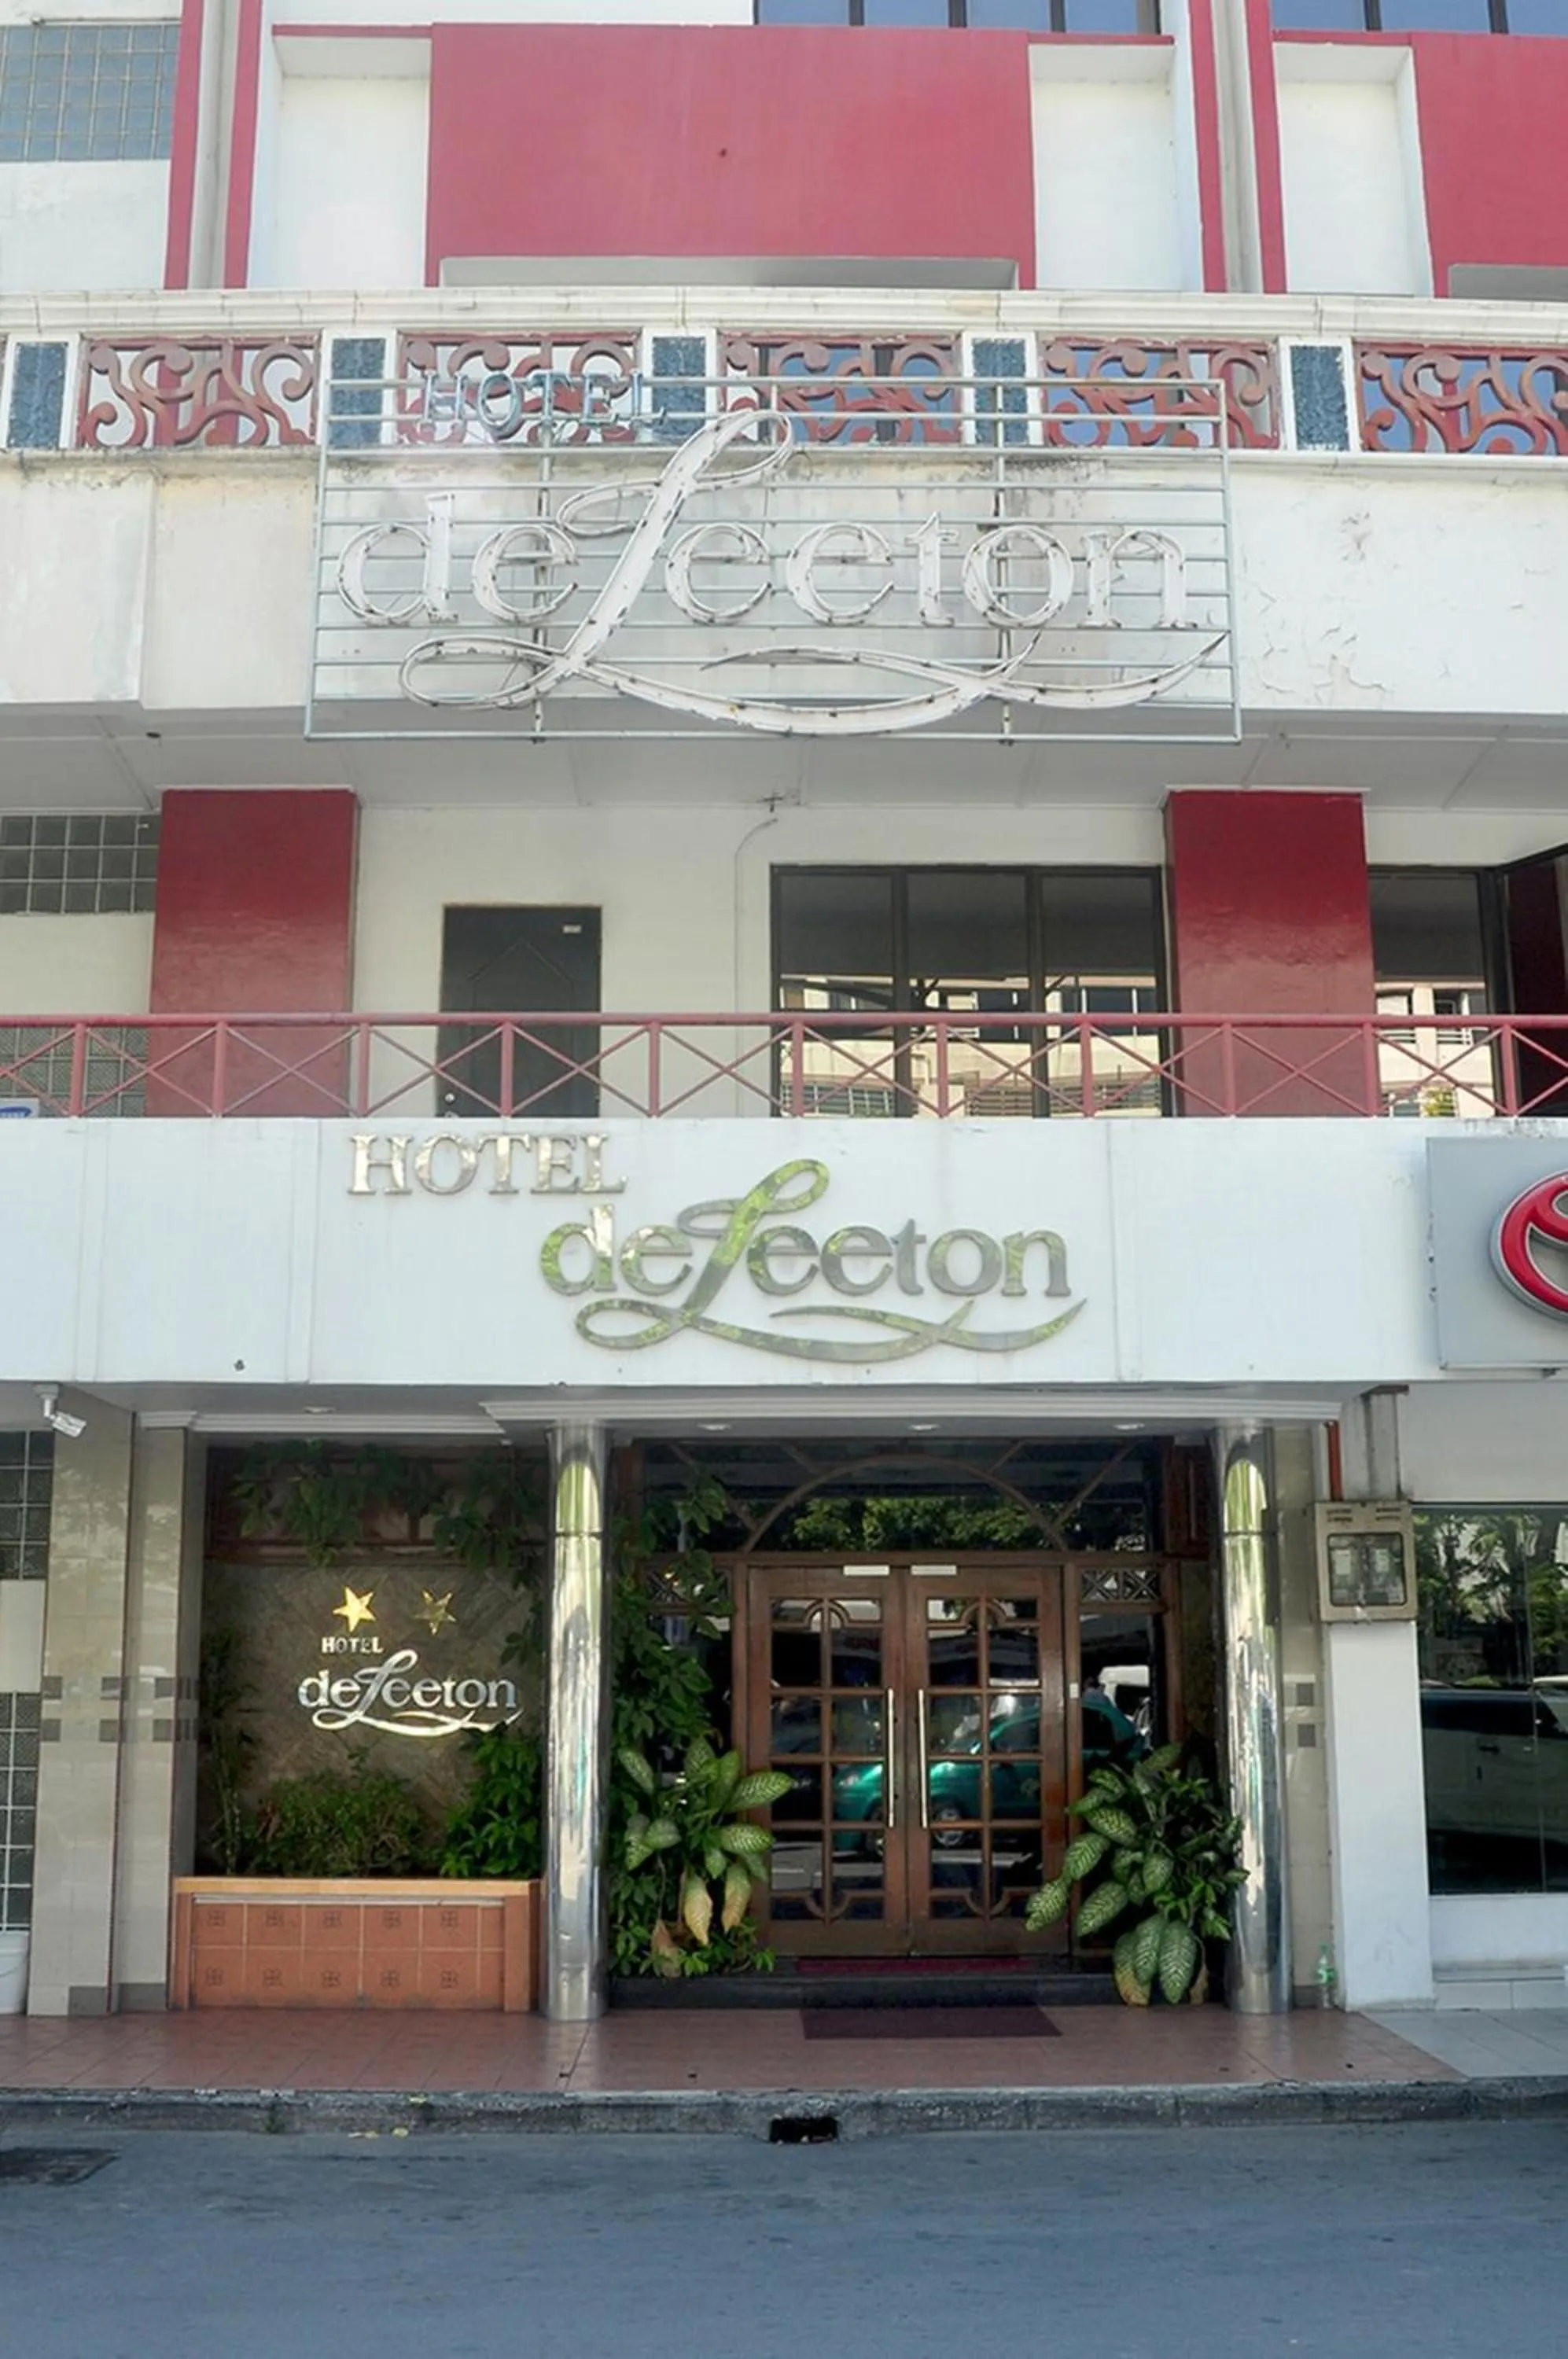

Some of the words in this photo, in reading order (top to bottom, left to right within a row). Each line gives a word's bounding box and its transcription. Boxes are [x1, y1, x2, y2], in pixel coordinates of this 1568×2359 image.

[420, 368, 667, 442] HOTEL
[348, 1133, 628, 1195] HOTEL
[322, 1637, 384, 1653] HOTEL
